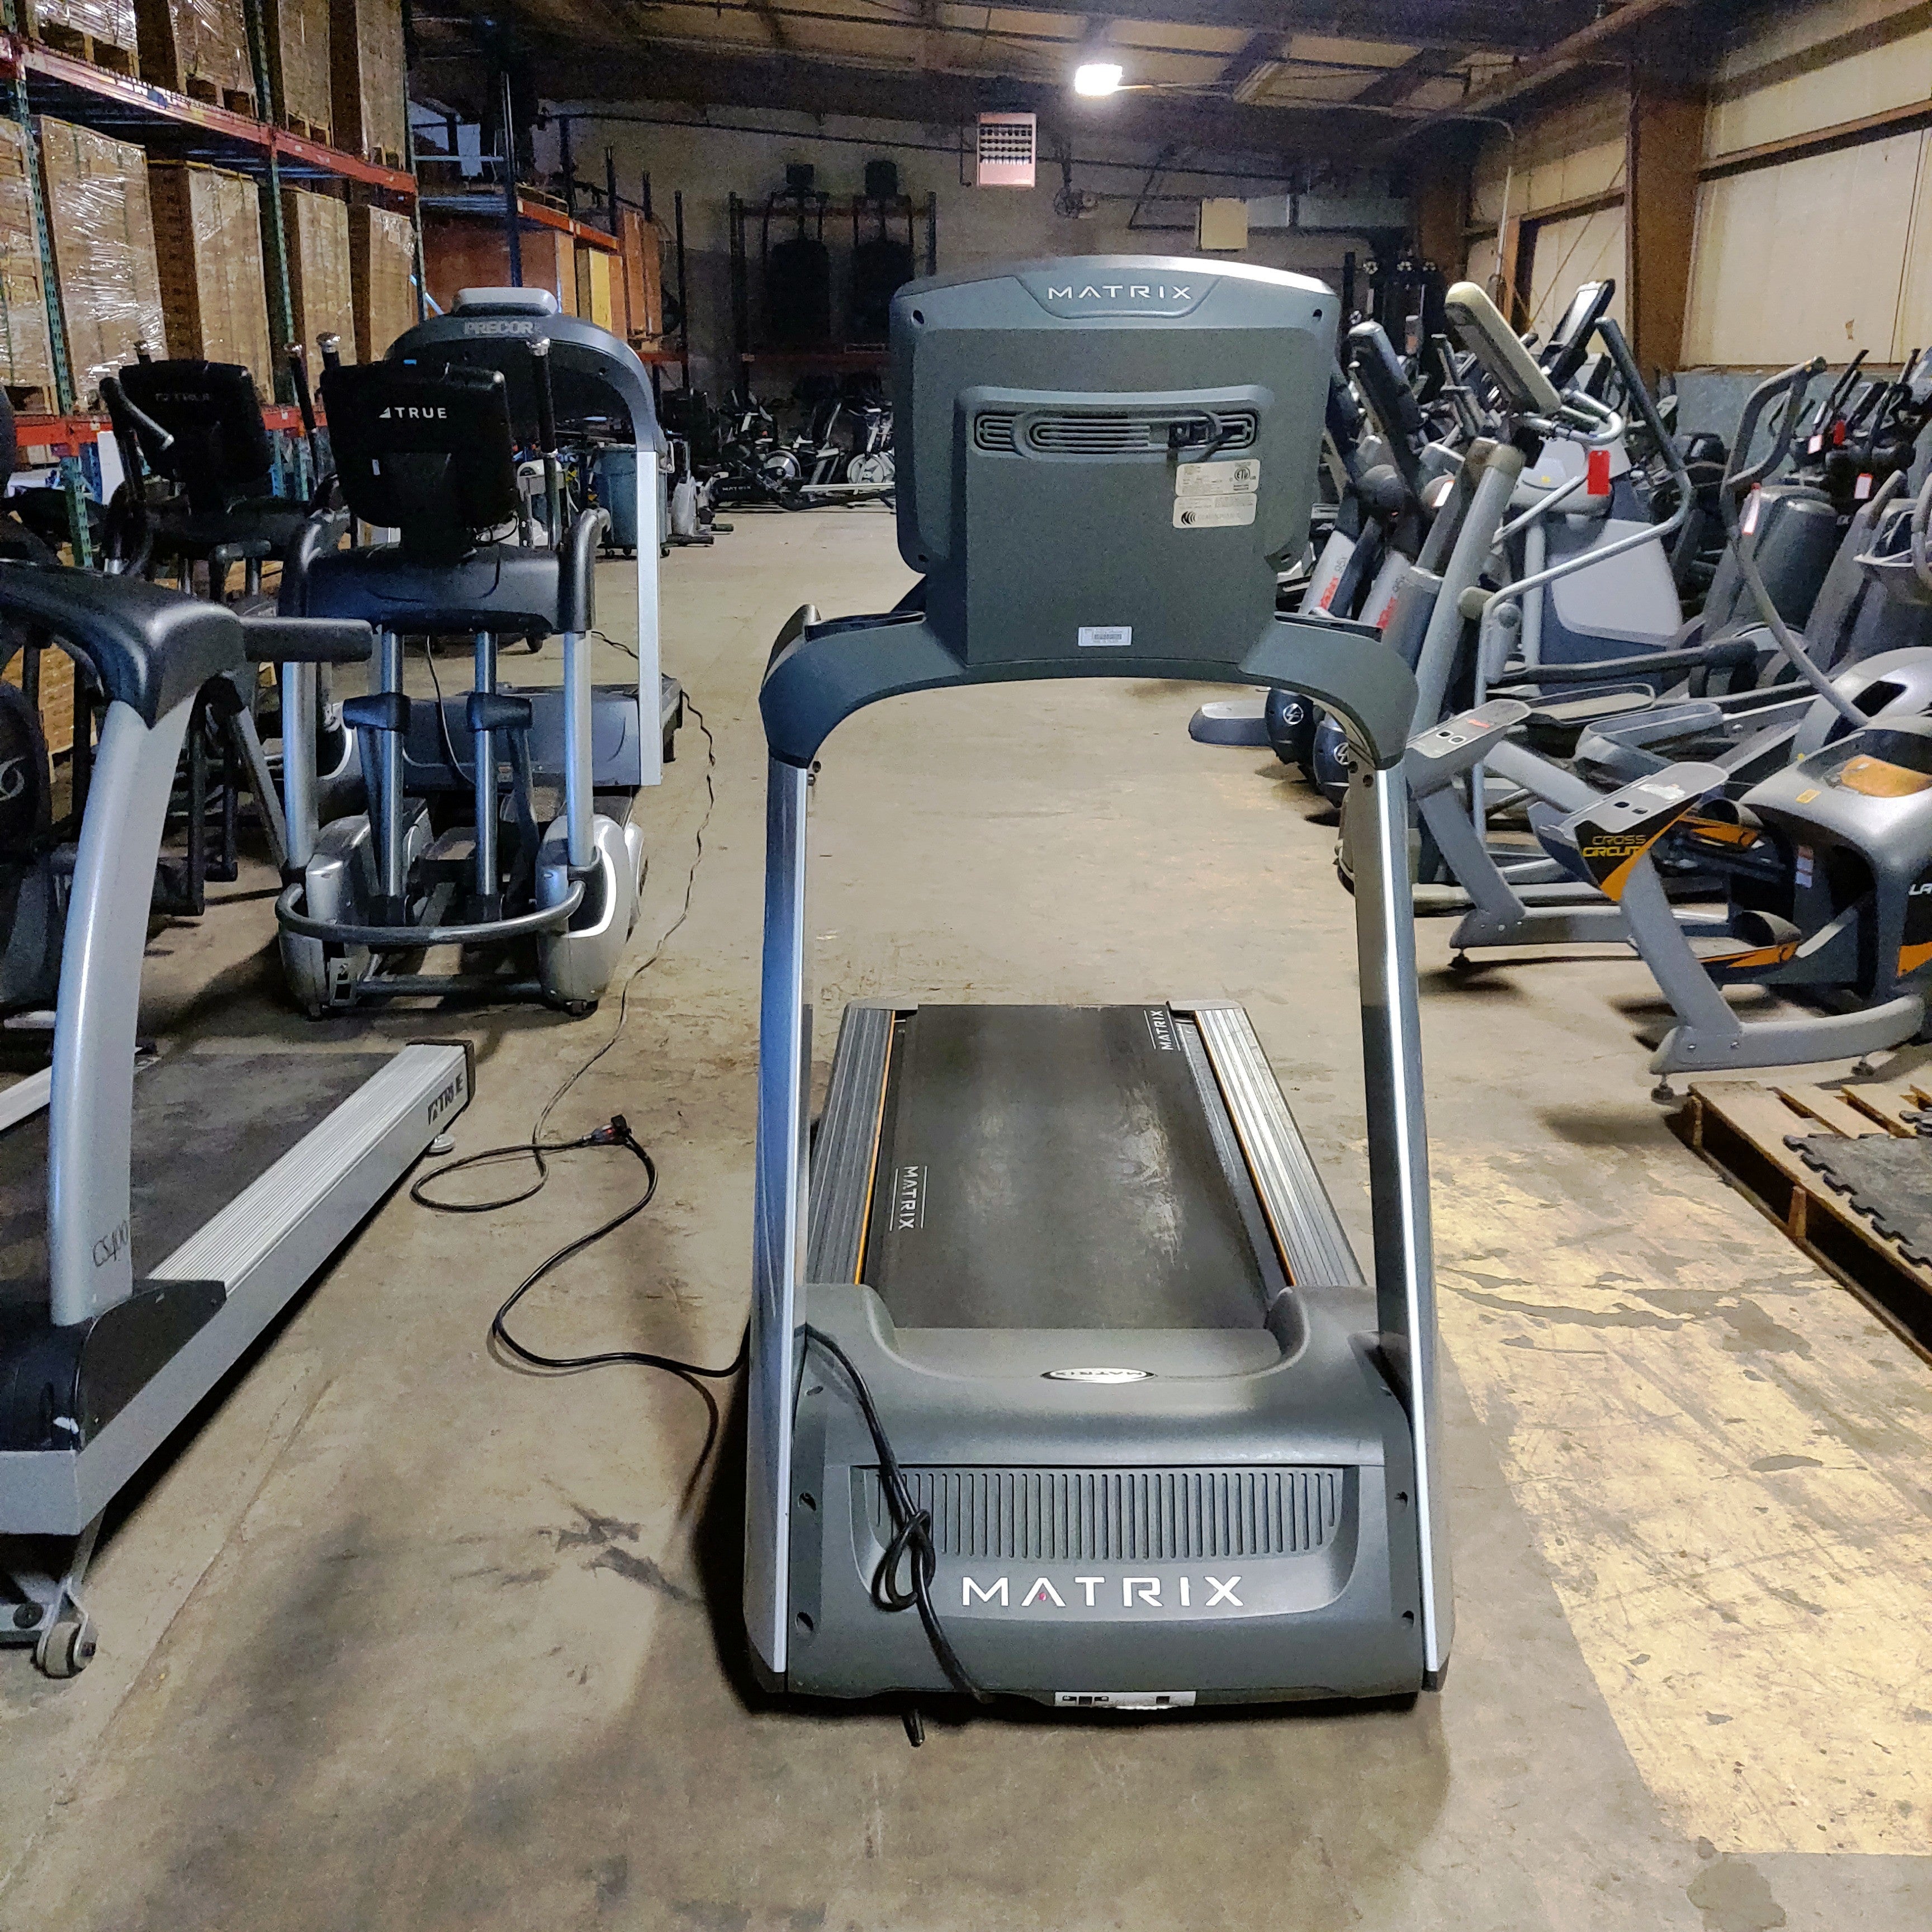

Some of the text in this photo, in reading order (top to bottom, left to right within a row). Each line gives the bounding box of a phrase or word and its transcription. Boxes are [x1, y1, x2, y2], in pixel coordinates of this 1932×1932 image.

[1048, 285, 1192, 300] MATRIX
[464, 320, 534, 335] PRECOR
[394, 407, 447, 419] TRUE
[1592, 835, 1646, 845] CROSS
[1150, 1010, 1174, 1050] MATRIX
[898, 1166, 919, 1230] MATRIX
[962, 1576, 1244, 1607] MATRIX
